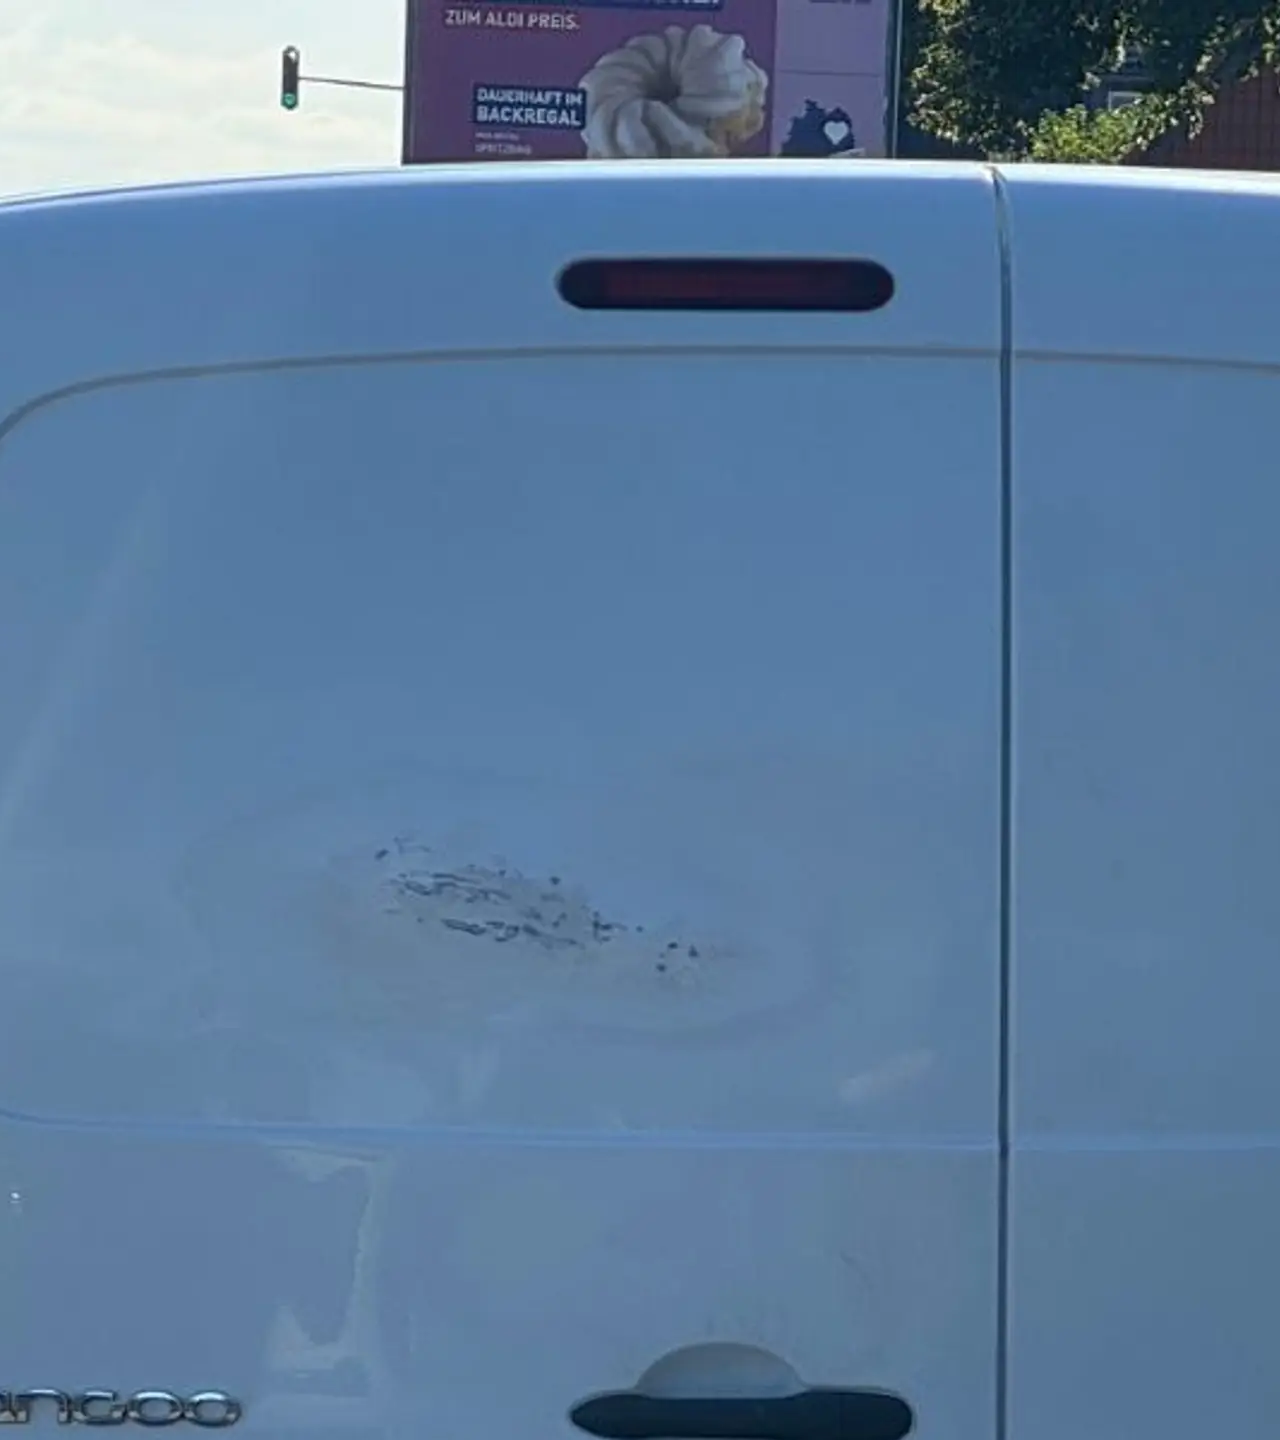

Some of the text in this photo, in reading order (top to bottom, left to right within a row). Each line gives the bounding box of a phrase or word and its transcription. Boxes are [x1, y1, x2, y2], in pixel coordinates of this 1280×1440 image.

[445, 9, 480, 25] ZUM
[485, 11, 523, 28] ALDI
[565, 92, 582, 105] IM
[476, 105, 582, 126] BACKREGAL
